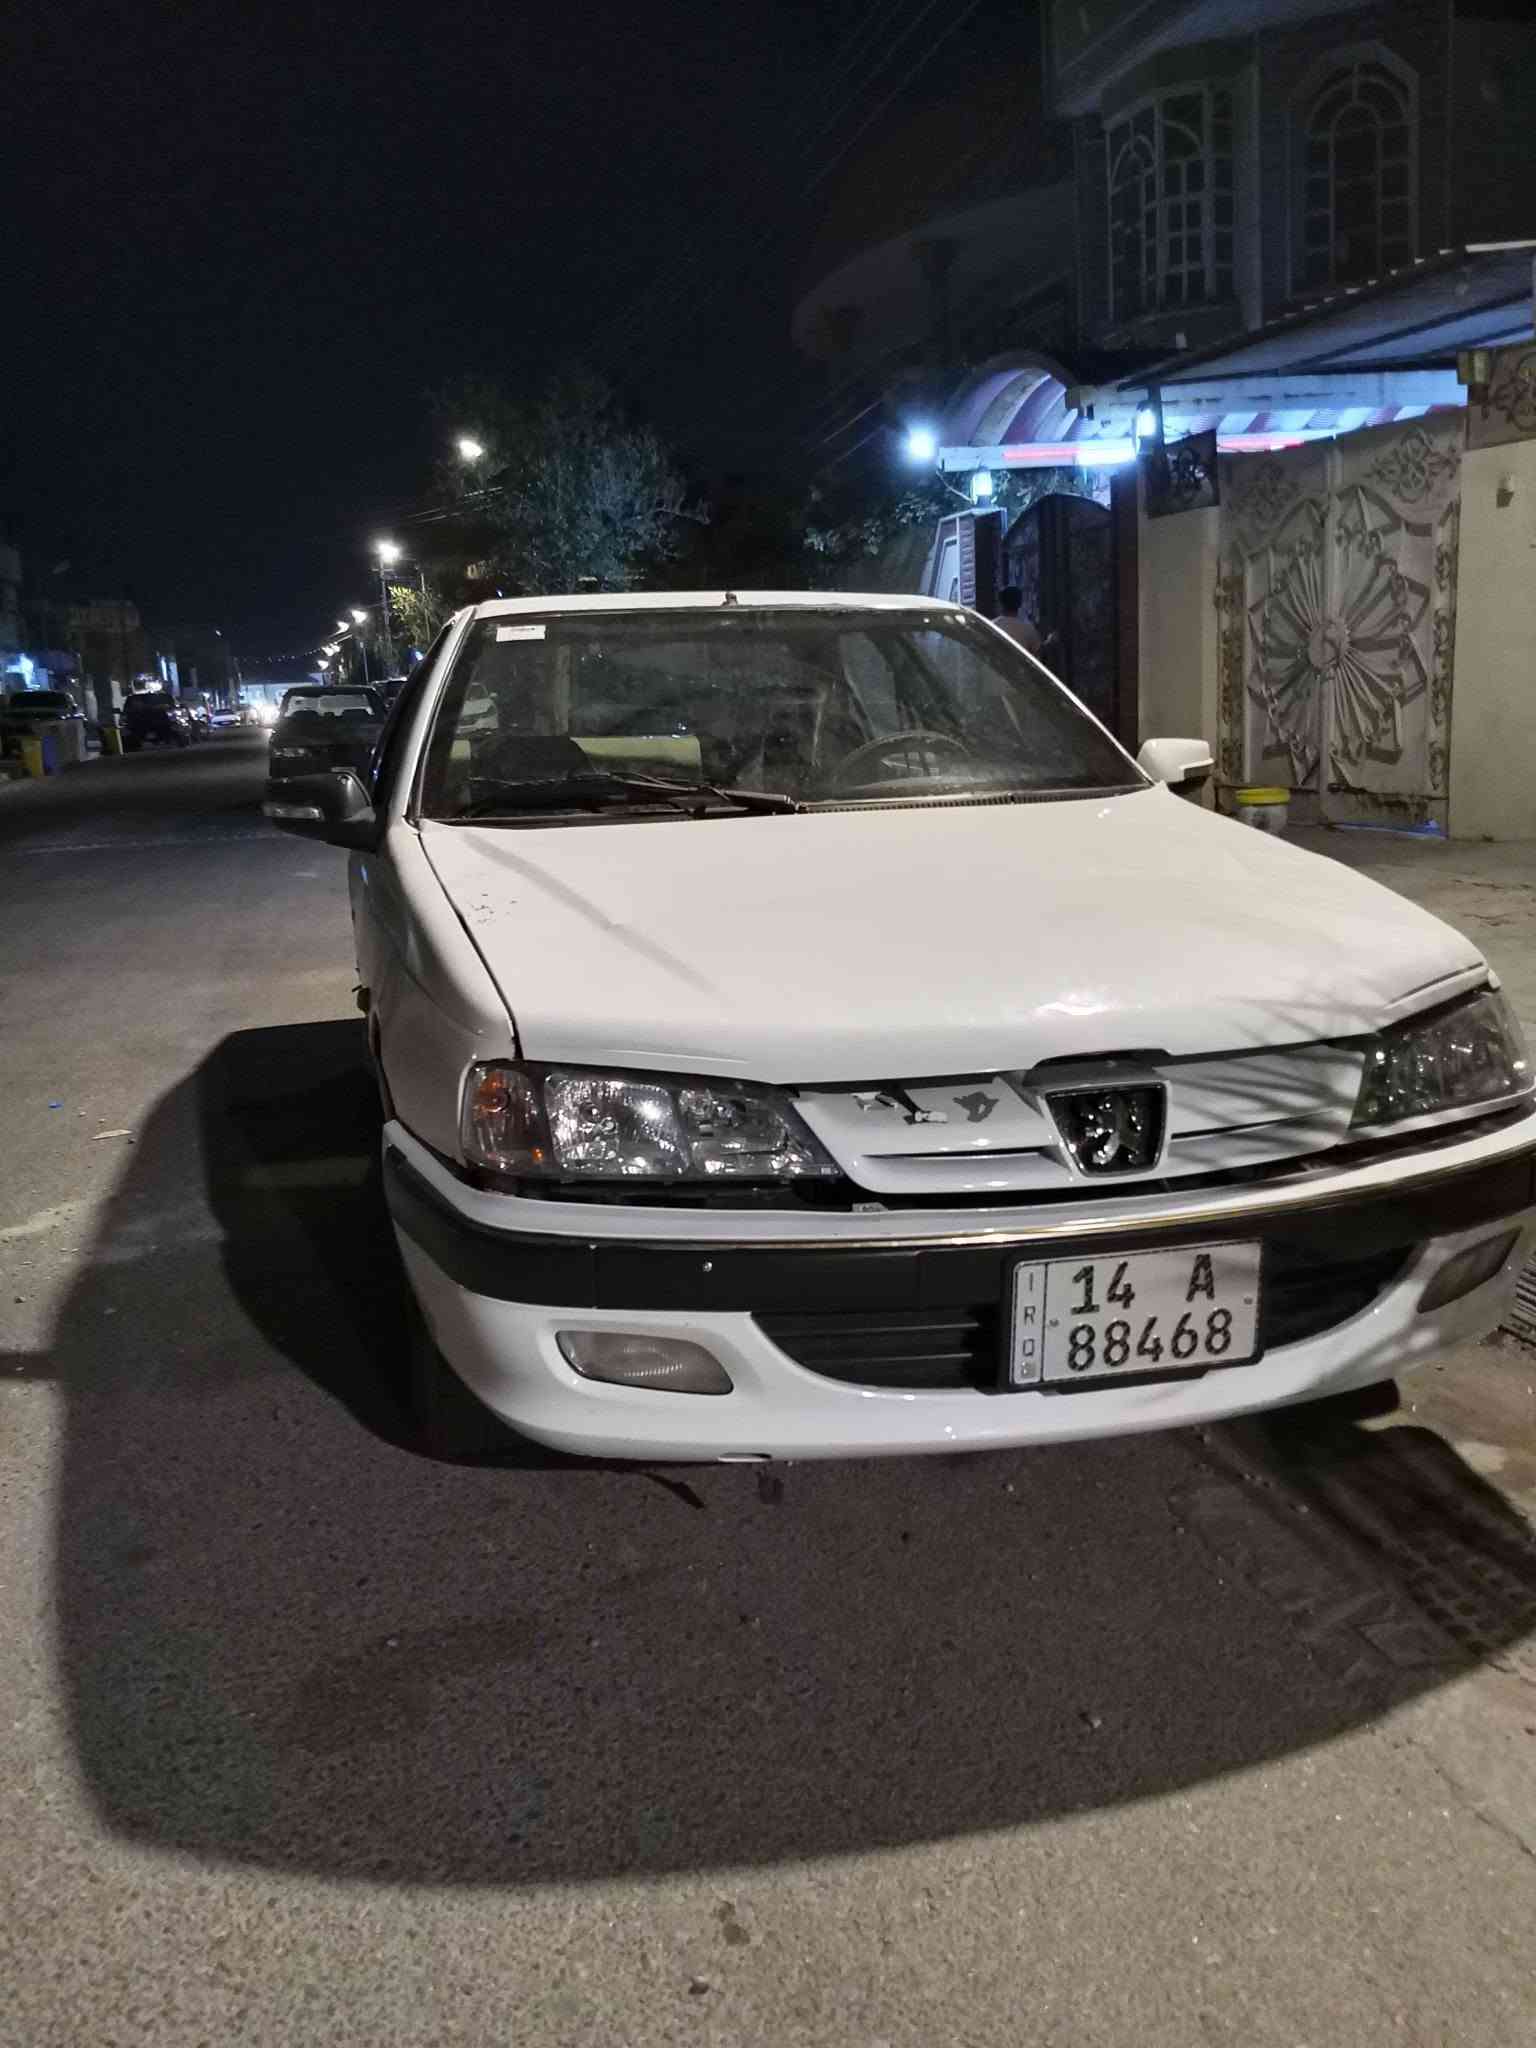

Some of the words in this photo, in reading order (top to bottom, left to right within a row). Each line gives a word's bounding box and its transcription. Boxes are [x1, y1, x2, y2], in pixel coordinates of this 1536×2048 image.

[1070, 1261, 1136, 1316] 14
[1185, 1254, 1216, 1303] A
[1067, 1308, 1233, 1372] 88468
